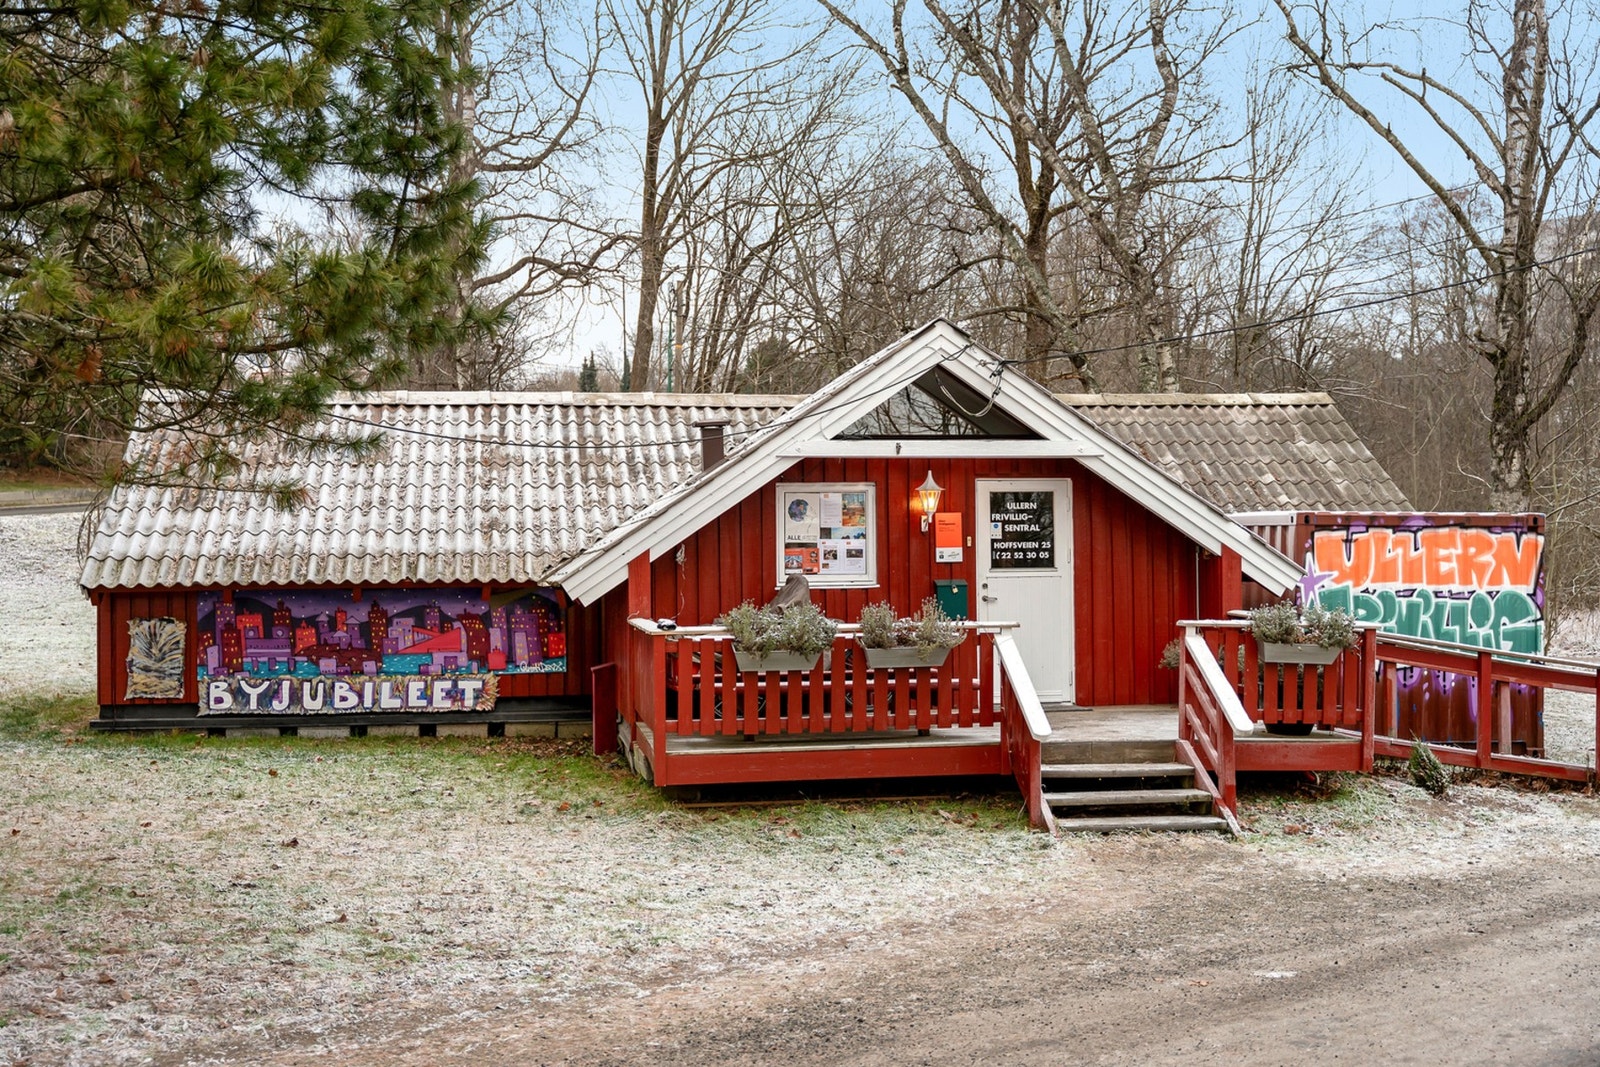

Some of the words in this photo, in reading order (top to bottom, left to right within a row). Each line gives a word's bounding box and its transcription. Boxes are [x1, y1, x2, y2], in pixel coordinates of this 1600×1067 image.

[1007, 502, 1037, 510] ULLERN
[991, 513, 1034, 521] FRIVILLIG-
[1004, 524, 1040, 532] SENTRAL
[993, 541, 1039, 549] HOFFSVEIEN
[1041, 541, 1051, 549] 25
[1001, 551, 1011, 559] 22
[1014, 551, 1024, 559] 52
[1026, 551, 1037, 559] 30
[1039, 551, 1049, 559] 05
[1314, 528, 1544, 589] ULLERN
[209, 679, 483, 711] BYJUBILEET
